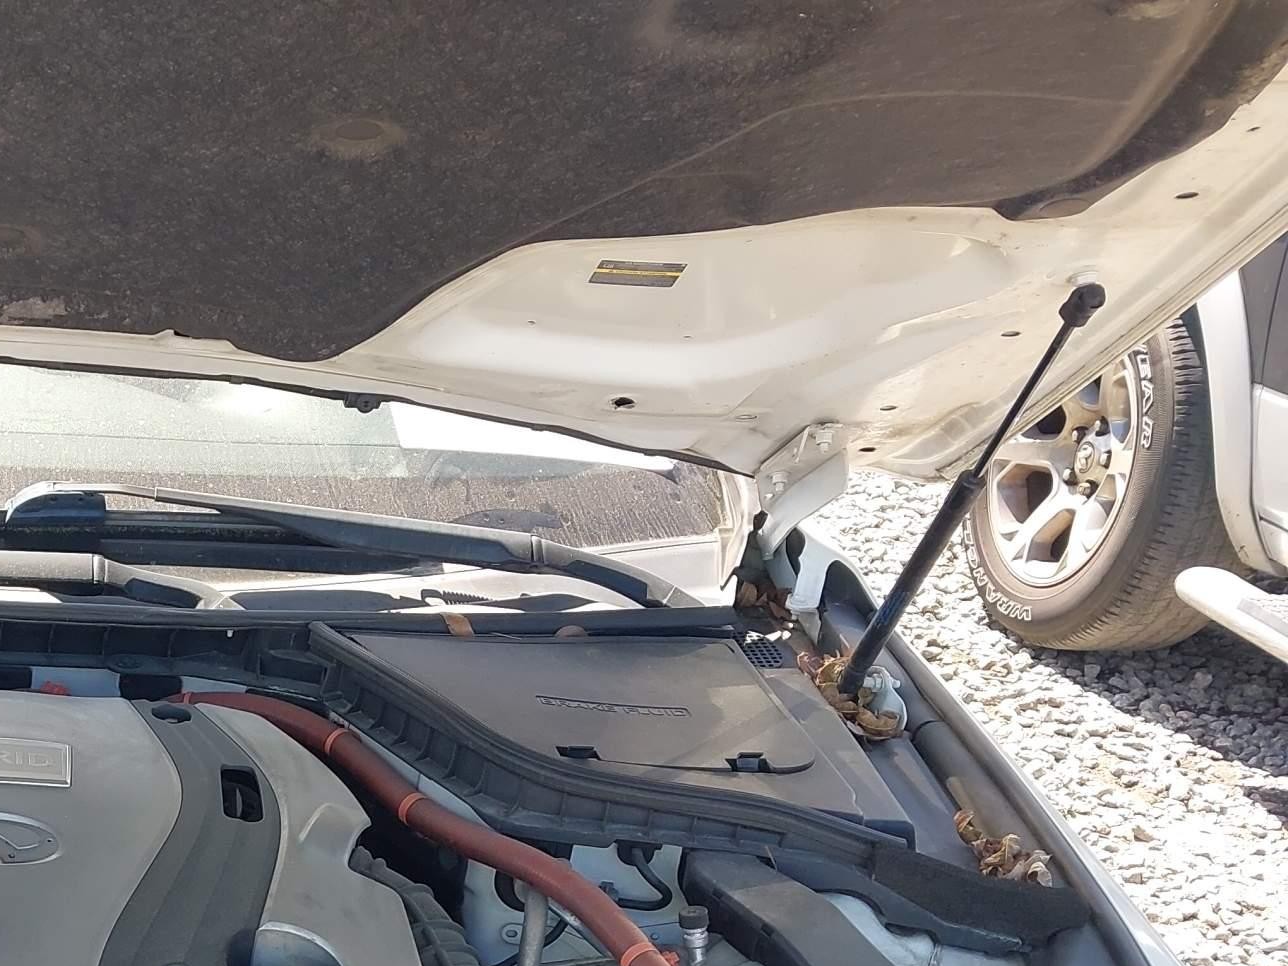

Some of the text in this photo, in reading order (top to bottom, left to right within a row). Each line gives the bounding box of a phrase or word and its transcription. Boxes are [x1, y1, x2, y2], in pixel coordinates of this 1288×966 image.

[963, 514, 1032, 621] WRANGL
[538, 697, 690, 717] BRAKE FLUID
